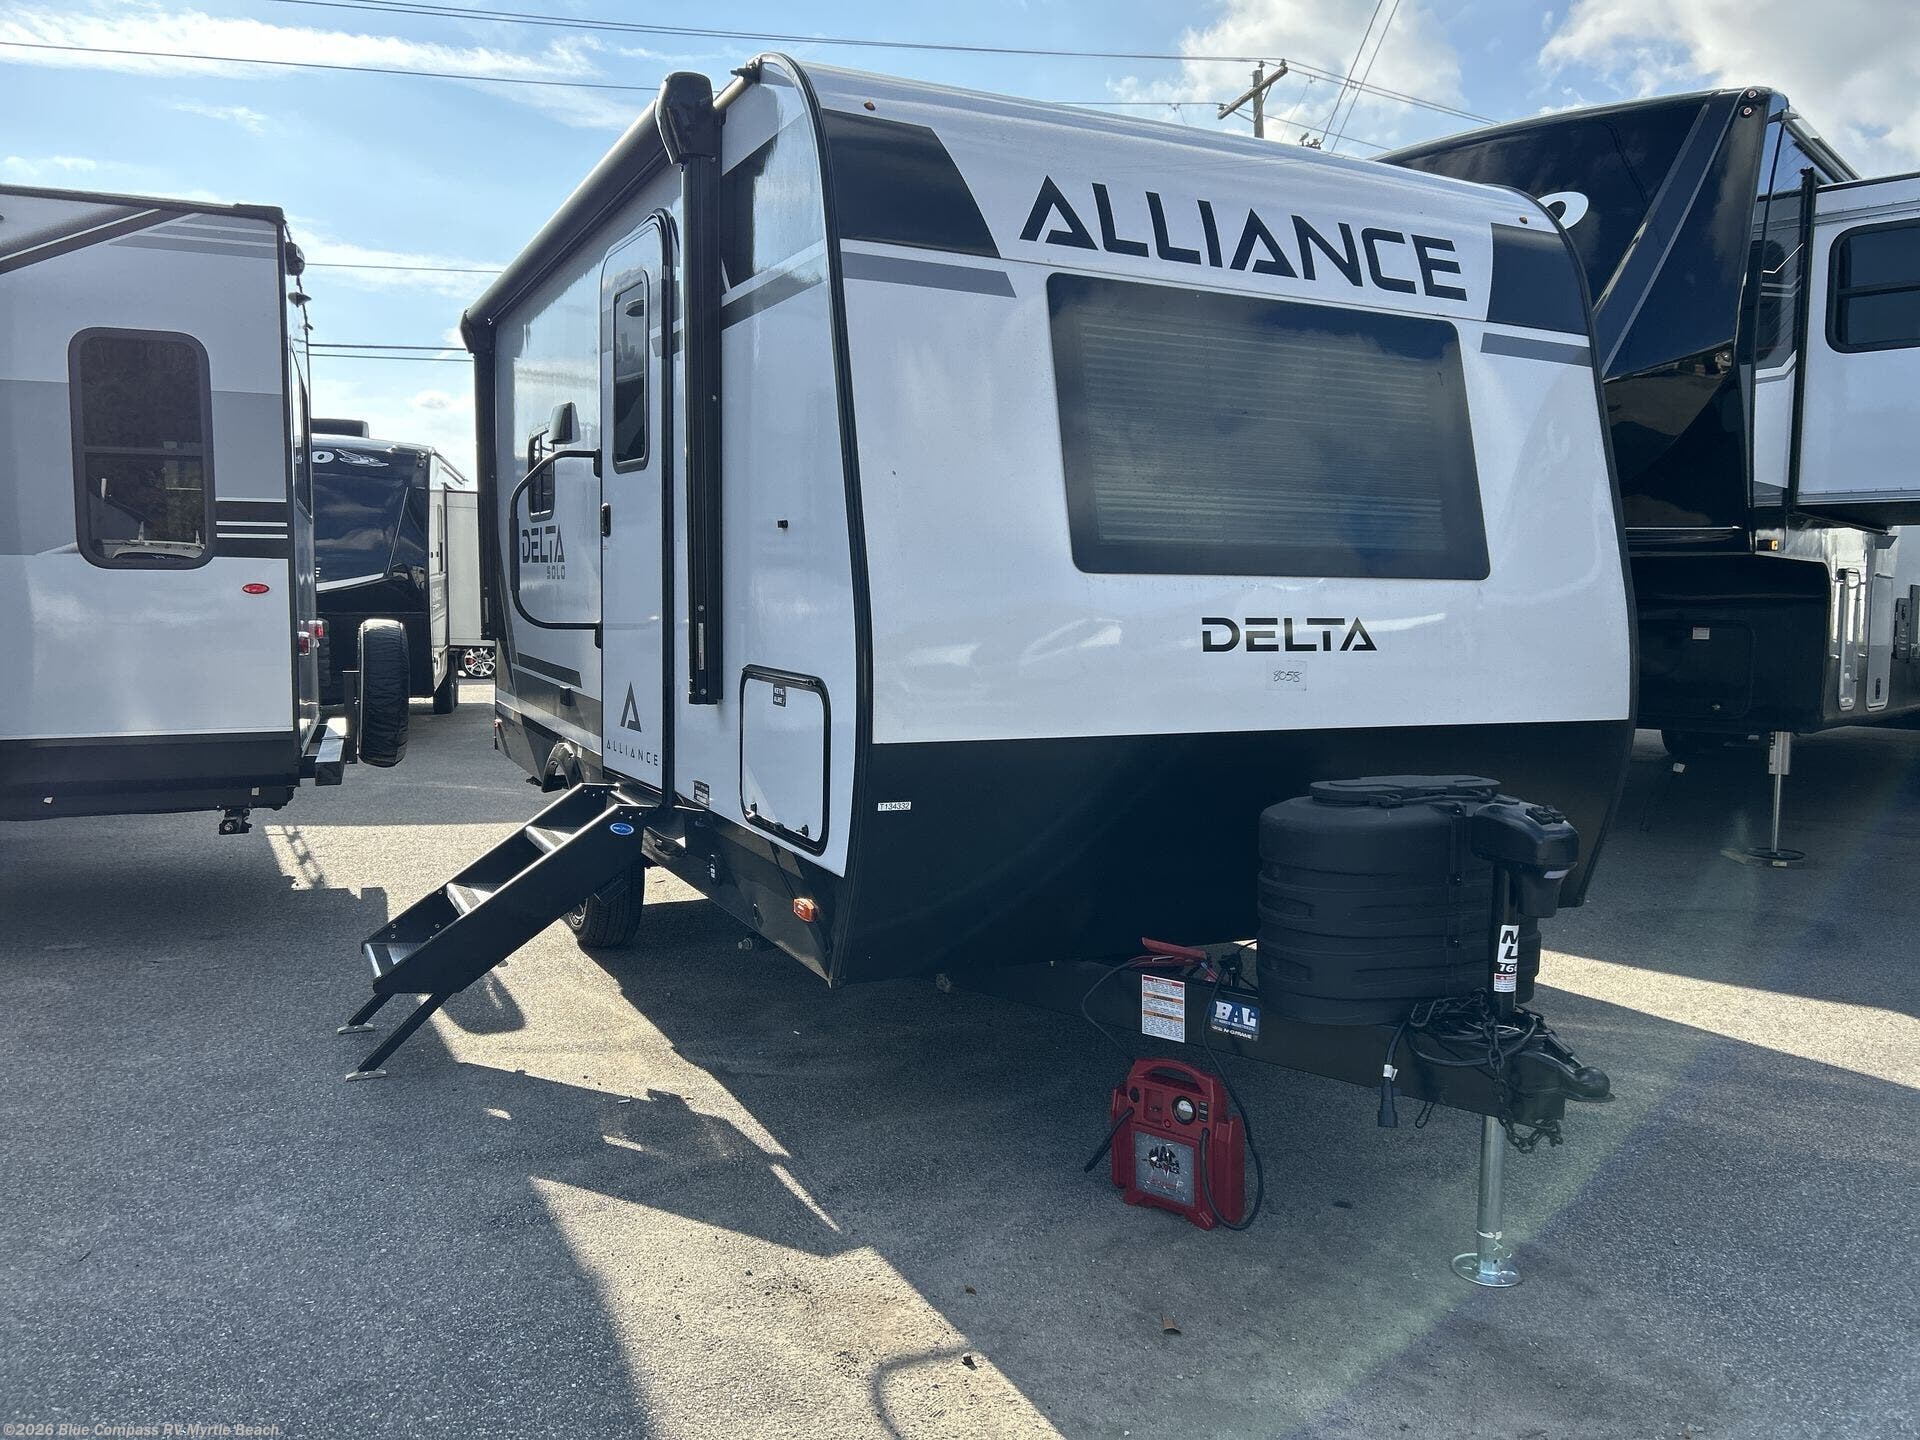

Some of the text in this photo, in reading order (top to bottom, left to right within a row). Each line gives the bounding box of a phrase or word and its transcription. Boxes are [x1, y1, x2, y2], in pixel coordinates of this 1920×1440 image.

[1019, 175, 1467, 301] ALLIANCE
[521, 524, 565, 564] DELTA
[546, 565, 566, 580] SOLO
[1202, 617, 1377, 652] DELTA
[1273, 670, 1302, 682] 8058
[606, 739, 658, 767] ALLIANCE
